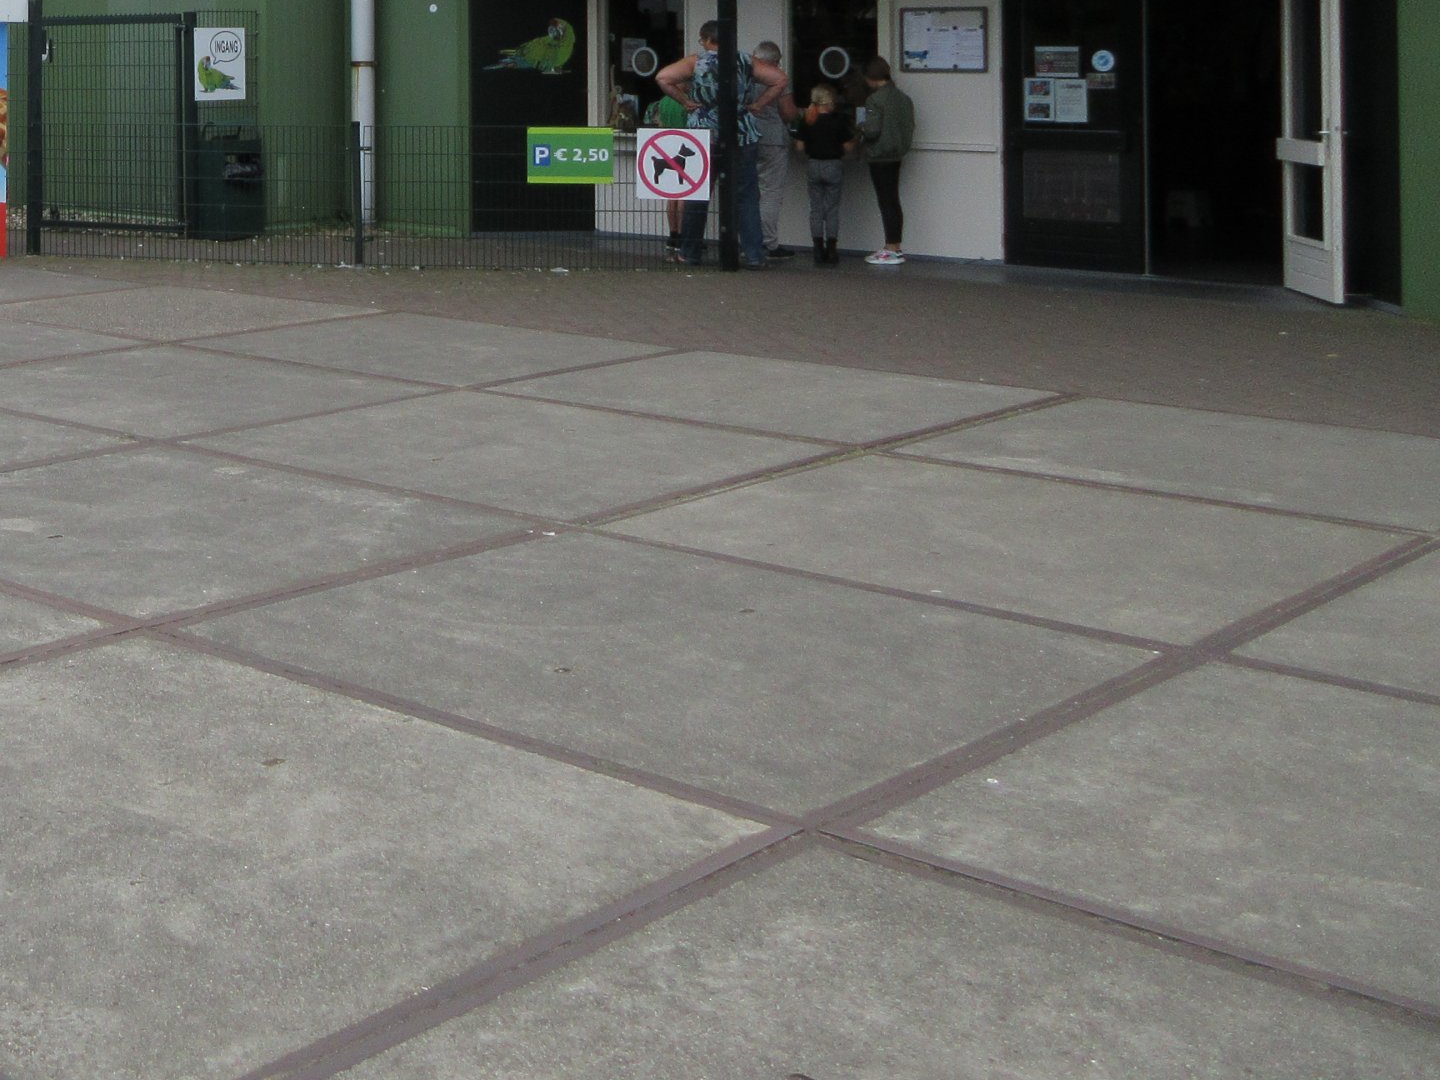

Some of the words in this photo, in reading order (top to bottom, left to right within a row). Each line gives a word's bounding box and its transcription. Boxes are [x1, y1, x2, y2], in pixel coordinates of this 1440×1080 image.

[215, 40, 239, 53] INGANG
[534, 147, 550, 164] P
[553, 148, 568, 161] €
[572, 148, 609, 163] 2,50
